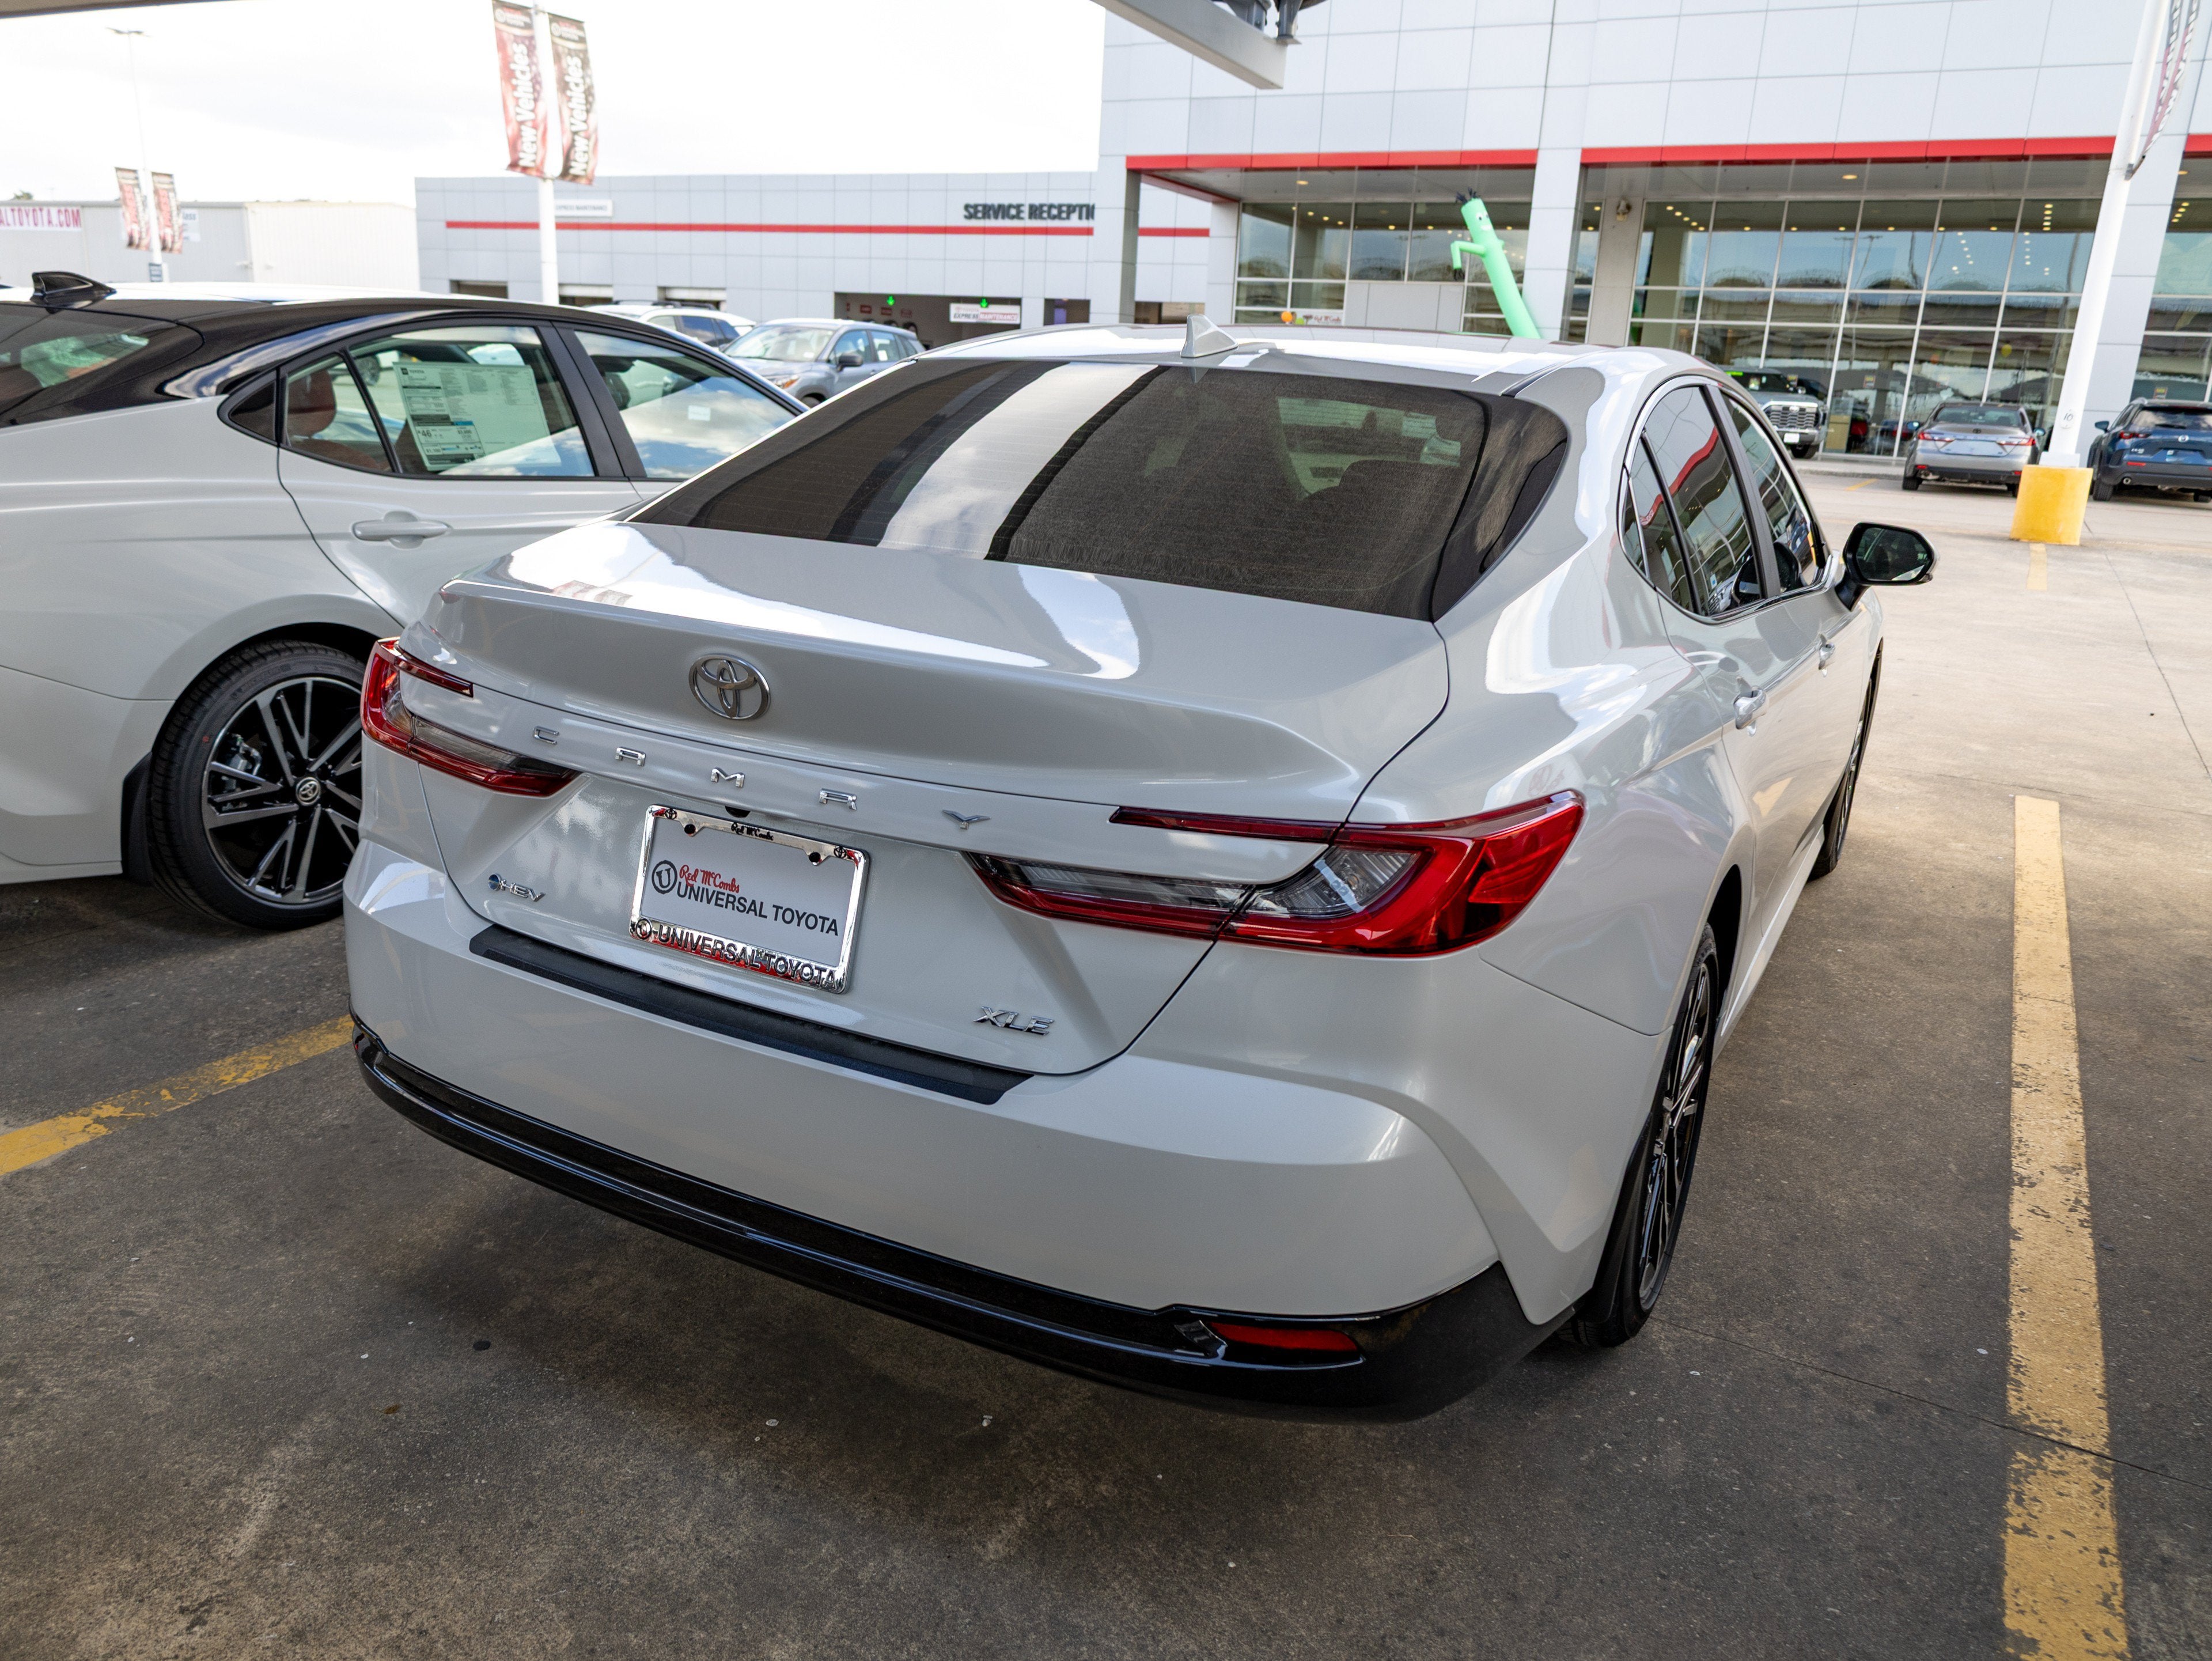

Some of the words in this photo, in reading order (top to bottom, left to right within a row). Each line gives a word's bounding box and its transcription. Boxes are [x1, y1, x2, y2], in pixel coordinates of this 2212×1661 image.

[509, 41, 536, 123] Vehicles
[964, 203, 1025, 220] SERVICE
[731, 822, 745, 835] Red
[746, 826, 774, 841] McCombs
[679, 864, 698, 885] Red
[700, 868, 740, 894] McCombs
[676, 881, 768, 919] UNIVERSAL
[771, 904, 839, 937] TOYOTA
[657, 924, 761, 968] UNIVERSAL
[763, 952, 837, 990] TOYOTA
[973, 1005, 1055, 1036] XLE
